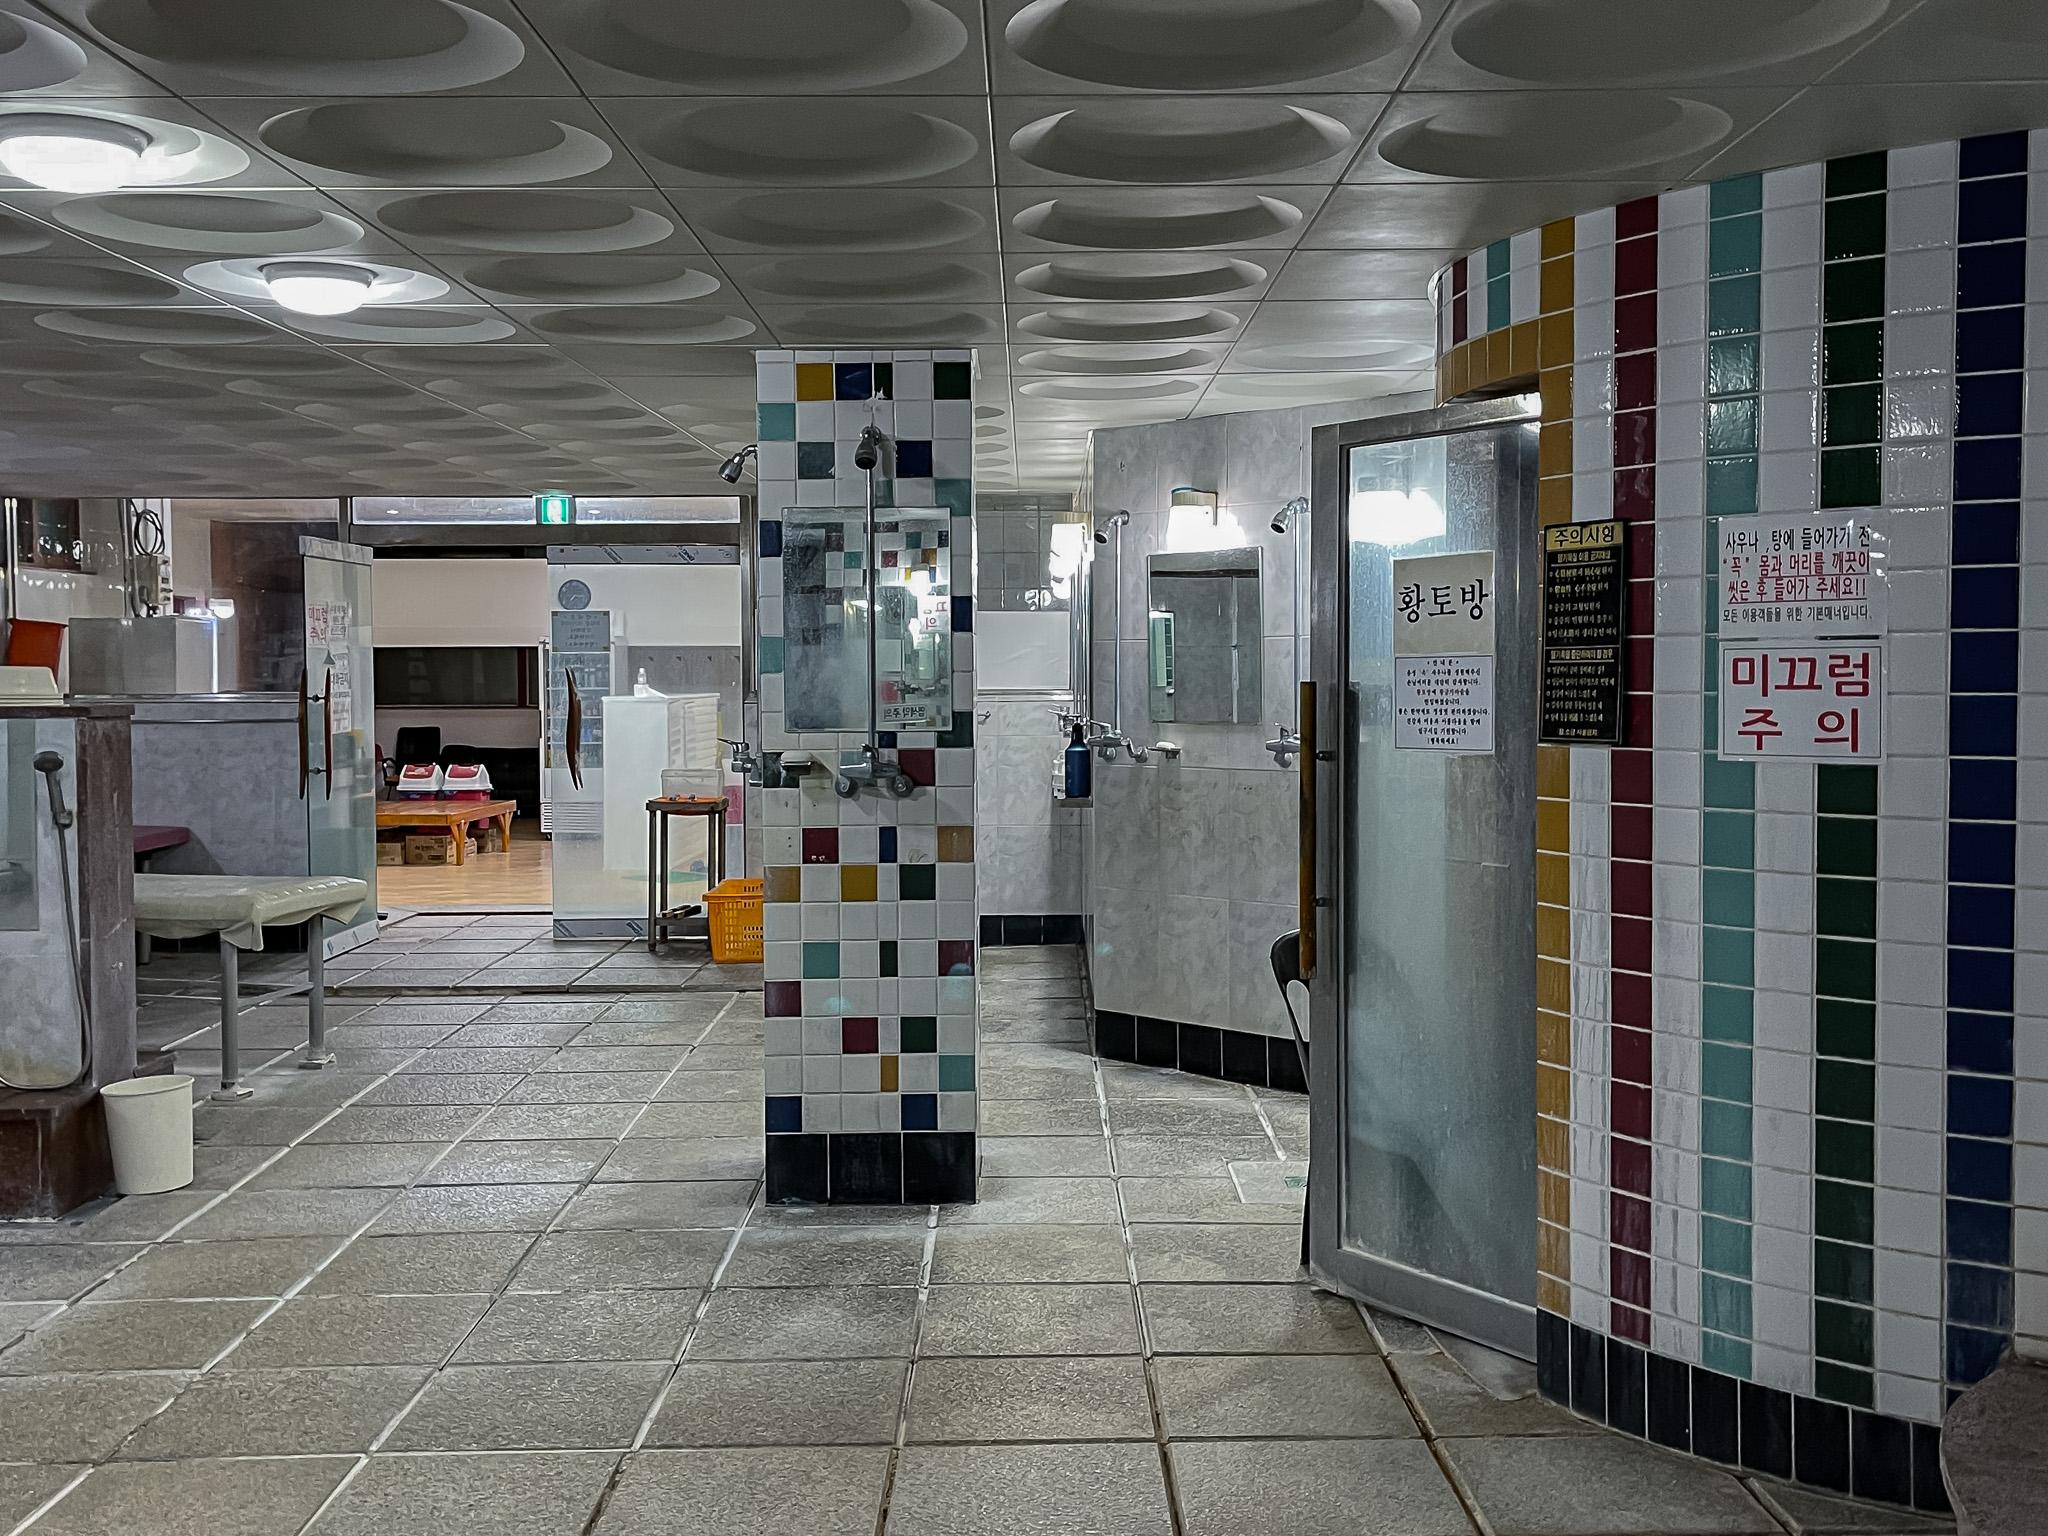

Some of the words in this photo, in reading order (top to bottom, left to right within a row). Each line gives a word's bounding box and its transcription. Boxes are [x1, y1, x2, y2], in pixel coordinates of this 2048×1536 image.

[1725, 530, 1759, 553] 사우나
[1800, 525, 1851, 551] 들어가기
[1858, 524, 1871, 548] 전
[1758, 554, 1783, 577] 몸과
[1789, 551, 1825, 577] 머리를
[1831, 549, 1871, 574] 깨끗이
[1397, 578, 1489, 623] 황토방
[1728, 580, 1750, 602] 씻은
[1756, 577, 1768, 601] 후
[1773, 577, 1810, 602] 들어가
[1815, 575, 1867, 599] 주세요!!
[1722, 608, 1738, 622] 모든
[1786, 606, 1803, 621] 위한
[1731, 652, 1870, 697] 미끄럼
